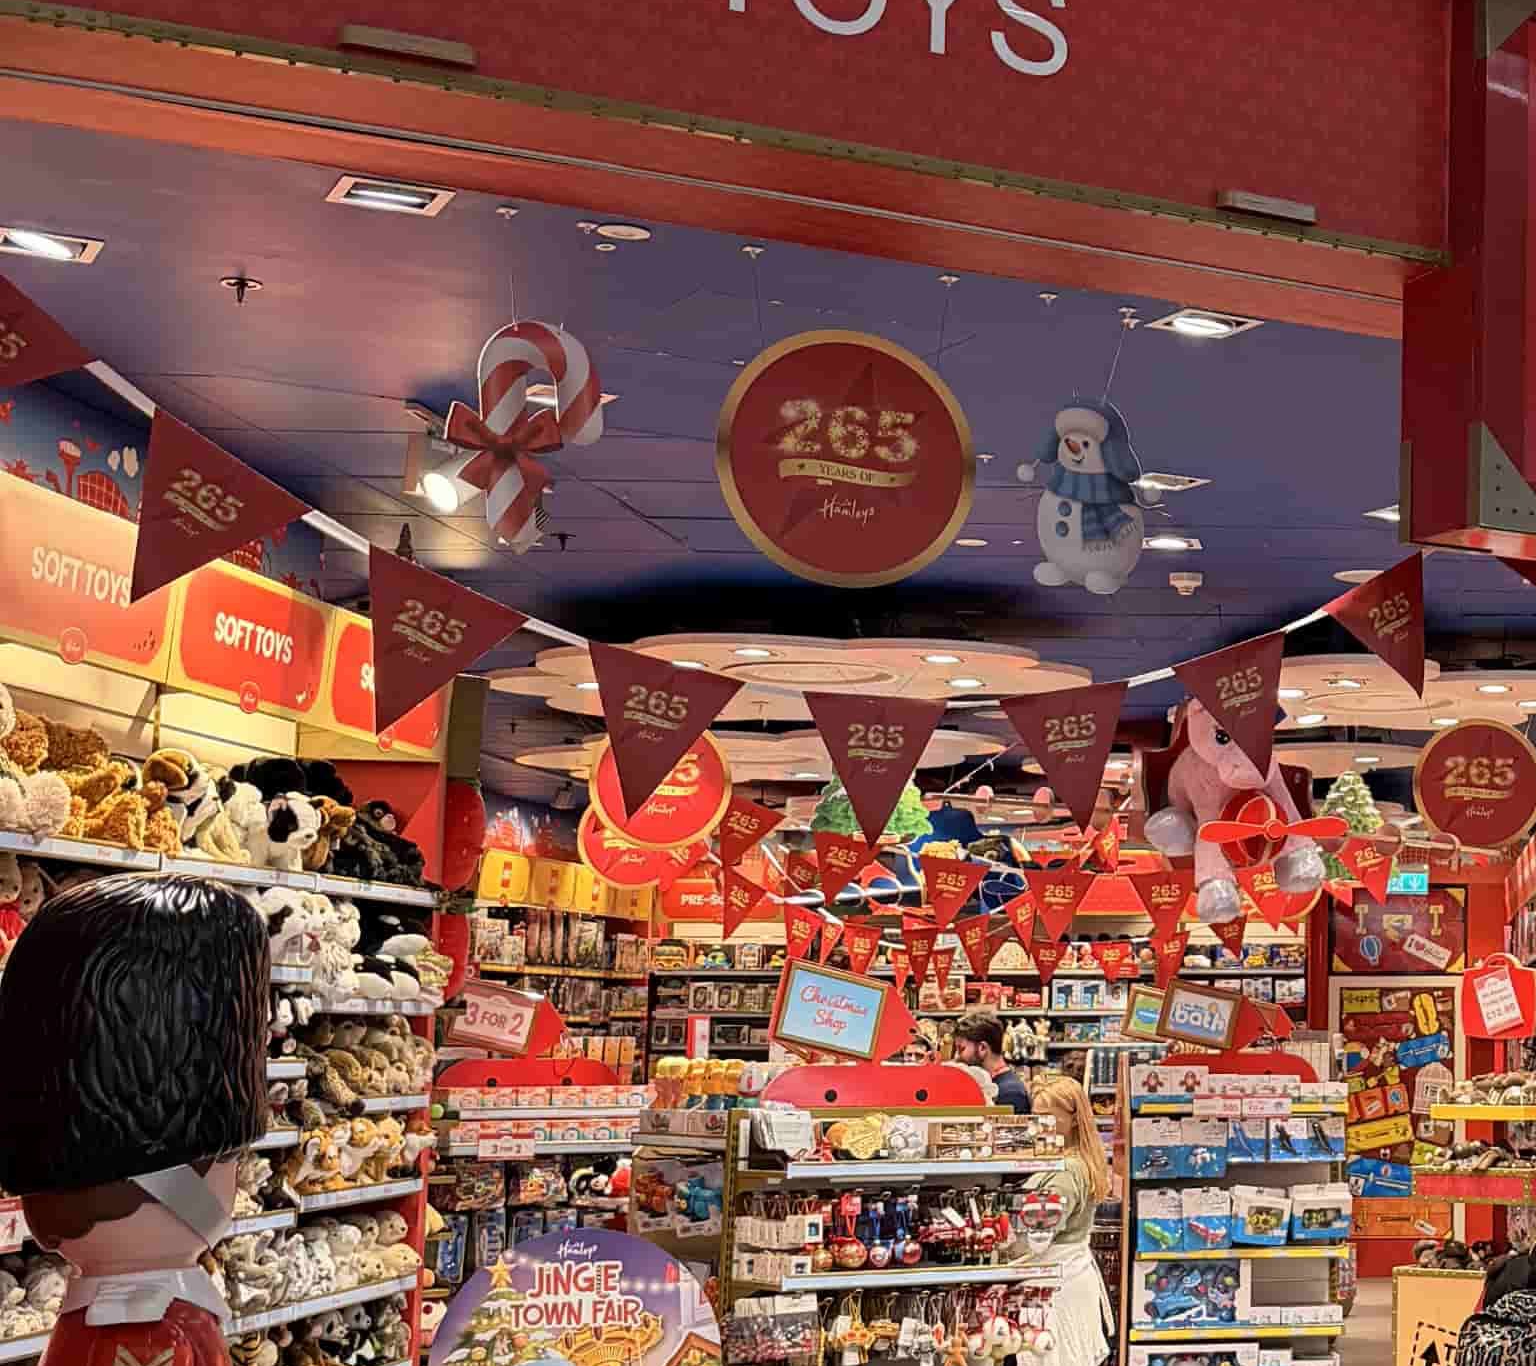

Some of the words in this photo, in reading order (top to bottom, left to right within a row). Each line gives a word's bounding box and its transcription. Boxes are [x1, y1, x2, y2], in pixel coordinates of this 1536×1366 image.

[777, 400, 920, 461] 265
[819, 464, 854, 482] YEARS
[172, 468, 245, 522] 265
[818, 492, 876, 525] Hamleys
[32, 546, 83, 592] SOFT
[83, 563, 130, 608] TOYS
[397, 599, 467, 645] 265
[1368, 594, 1410, 628] 265
[215, 612, 252, 650] SOFT
[252, 625, 293, 664] TOYS
[1216, 667, 1262, 695] 265
[624, 684, 689, 721] 265
[848, 725, 903, 748] 265
[1045, 715, 1096, 742] 265
[1443, 756, 1517, 785] 265
[728, 811, 760, 830] 265
[830, 846, 856, 863] 265
[935, 872, 966, 888] 265
[1044, 884, 1075, 898] 265
[1151, 884, 1181, 898] 265
[801, 986, 868, 1017] Christmas
[463, 1001, 477, 1025] 3
[480, 1011, 507, 1029] FOR
[511, 1012, 525, 1035] 2
[812, 1009, 847, 1033] Shop
[511, 1300, 587, 1329] TOWN
